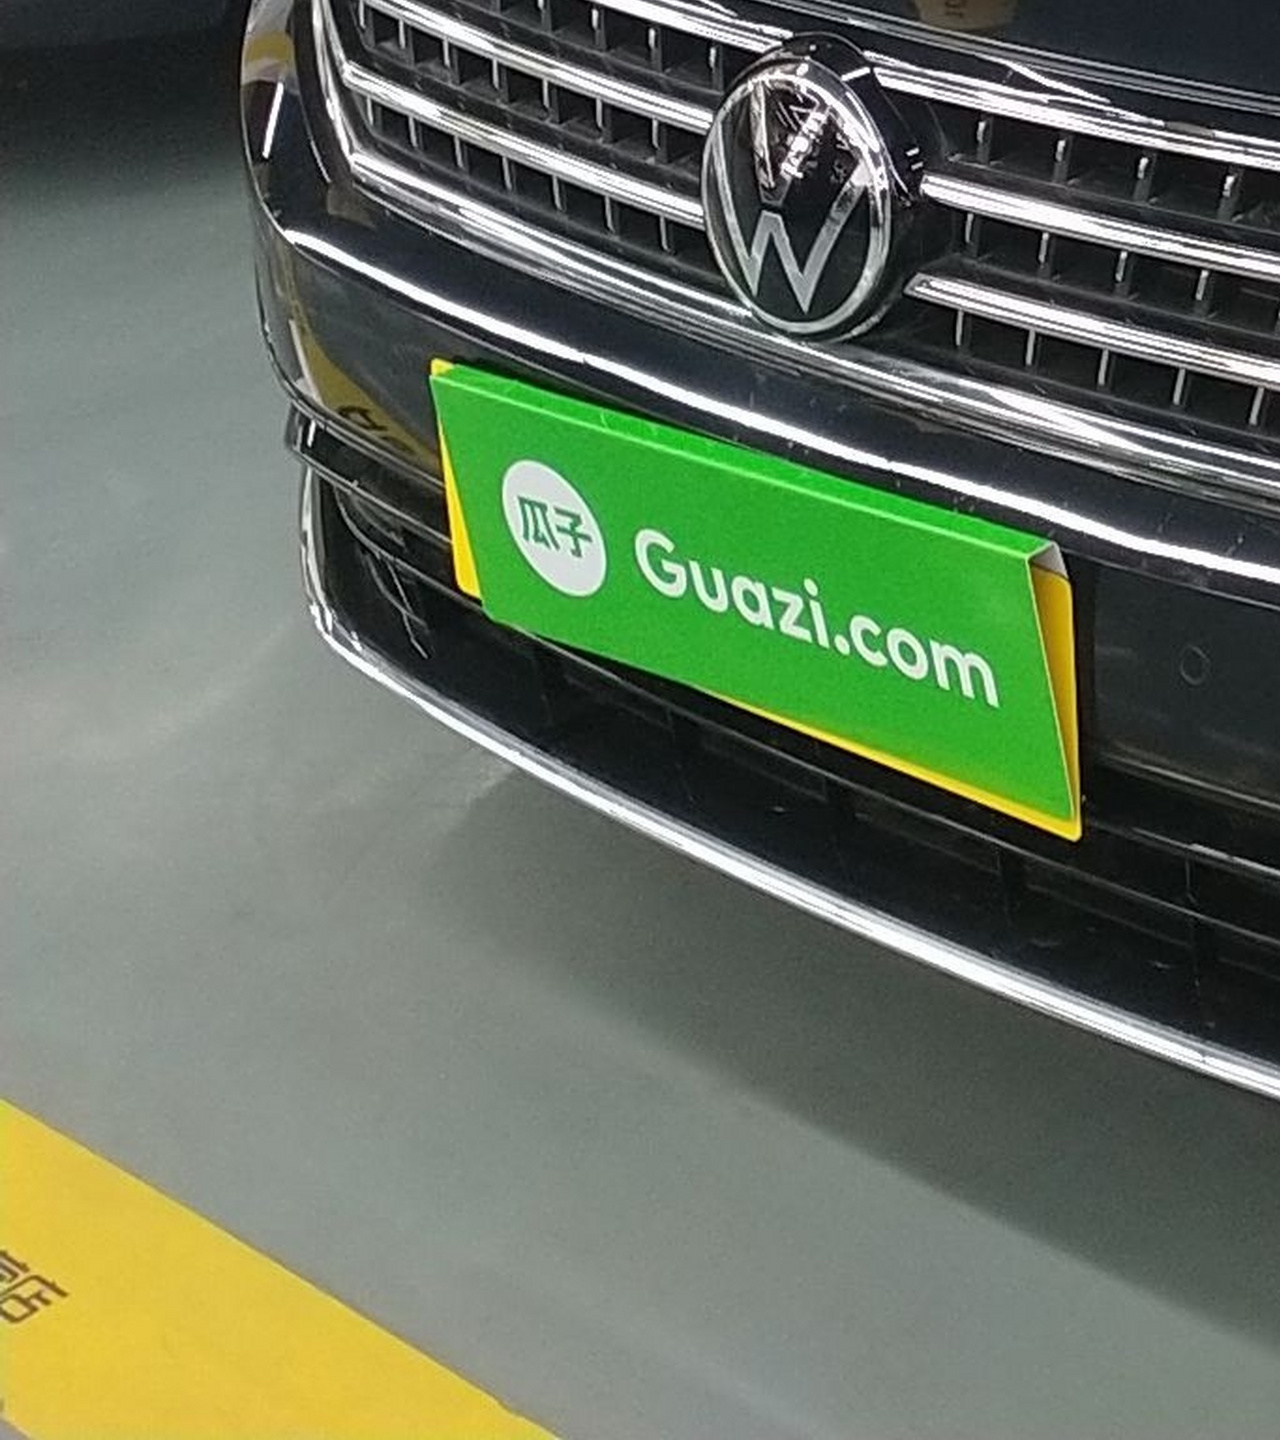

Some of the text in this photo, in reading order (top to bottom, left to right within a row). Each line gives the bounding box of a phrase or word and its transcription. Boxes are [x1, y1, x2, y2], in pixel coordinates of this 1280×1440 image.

[517, 495, 594, 559] 瓜子
[634, 528, 999, 709] Guazi.com
[0, 1250, 69, 1324] 店
